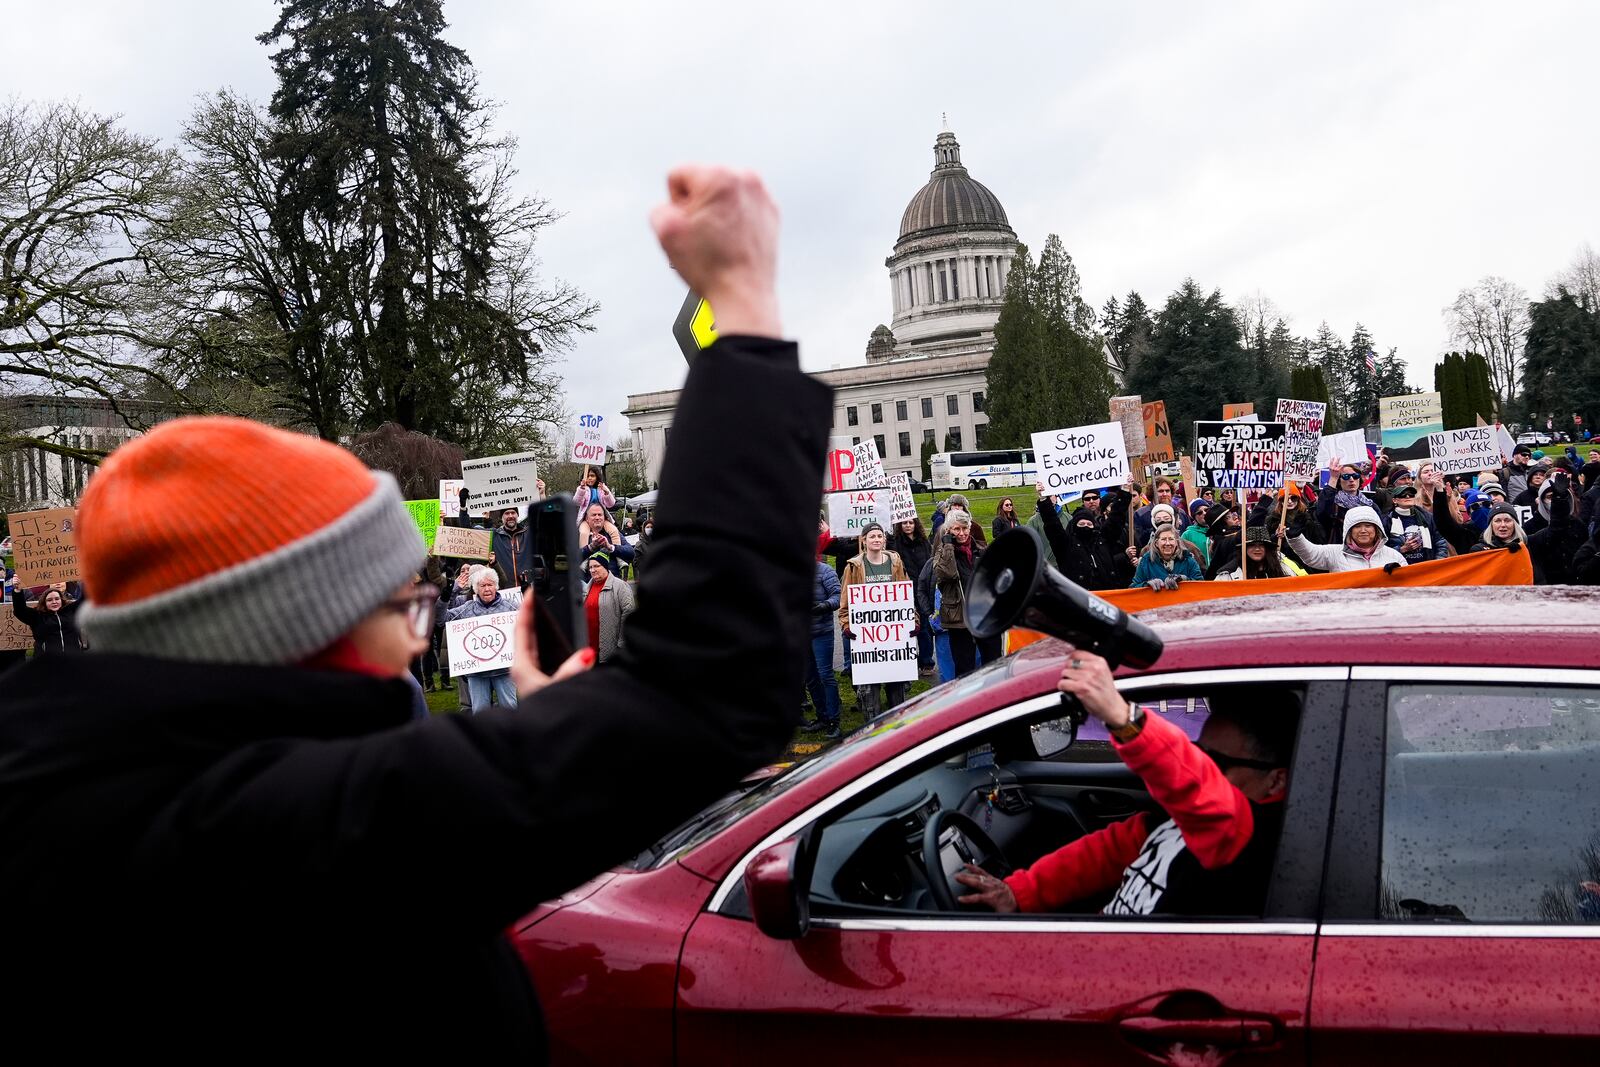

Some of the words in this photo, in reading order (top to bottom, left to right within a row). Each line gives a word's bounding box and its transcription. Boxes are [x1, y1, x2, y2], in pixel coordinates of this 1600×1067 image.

[1390, 398, 1431, 410] PROUDLY
[1399, 409, 1424, 418] ANTI-
[580, 414, 603, 428] STOP
[1391, 416, 1431, 428] FASCIST
[1222, 424, 1266, 440] STOP
[1430, 434, 1445, 446] NO
[1452, 428, 1490, 442] NAZIS
[1056, 433, 1095, 450] Stop
[1198, 435, 1285, 452] PRETENDING
[574, 442, 604, 460] COUP
[1432, 446, 1447, 458] NO
[464, 463, 490, 472] KINDNESS
[502, 457, 535, 466] RESISTANCE
[856, 451, 874, 467] MEN
[1042, 447, 1118, 470] Executive
[1198, 452, 1226, 469] YOUR
[1234, 452, 1283, 470] RACISM
[858, 470, 878, 483] ANGE
[878, 474, 906, 488] ANGRY
[1048, 460, 1122, 488] Overreach!
[1196, 470, 1208, 486] IS
[1212, 470, 1284, 488] PATRIOTISM
[500, 487, 523, 495] CANNOT
[892, 484, 908, 494] MEN
[849, 491, 876, 504] TAX
[470, 502, 494, 510] OUTLIVE
[852, 505, 874, 516] THE
[847, 517, 878, 528] RICH
[450, 528, 472, 538] BETTER
[34, 535, 60, 547] Bad
[450, 545, 482, 555] POSSIBLE
[35, 572, 53, 581] ARE
[848, 583, 912, 604] FIGHT
[851, 608, 915, 624] ignorance
[862, 624, 904, 644] NOT
[472, 634, 501, 650] 2025
[500, 653, 512, 662] MU
[851, 642, 918, 664] immigrants
